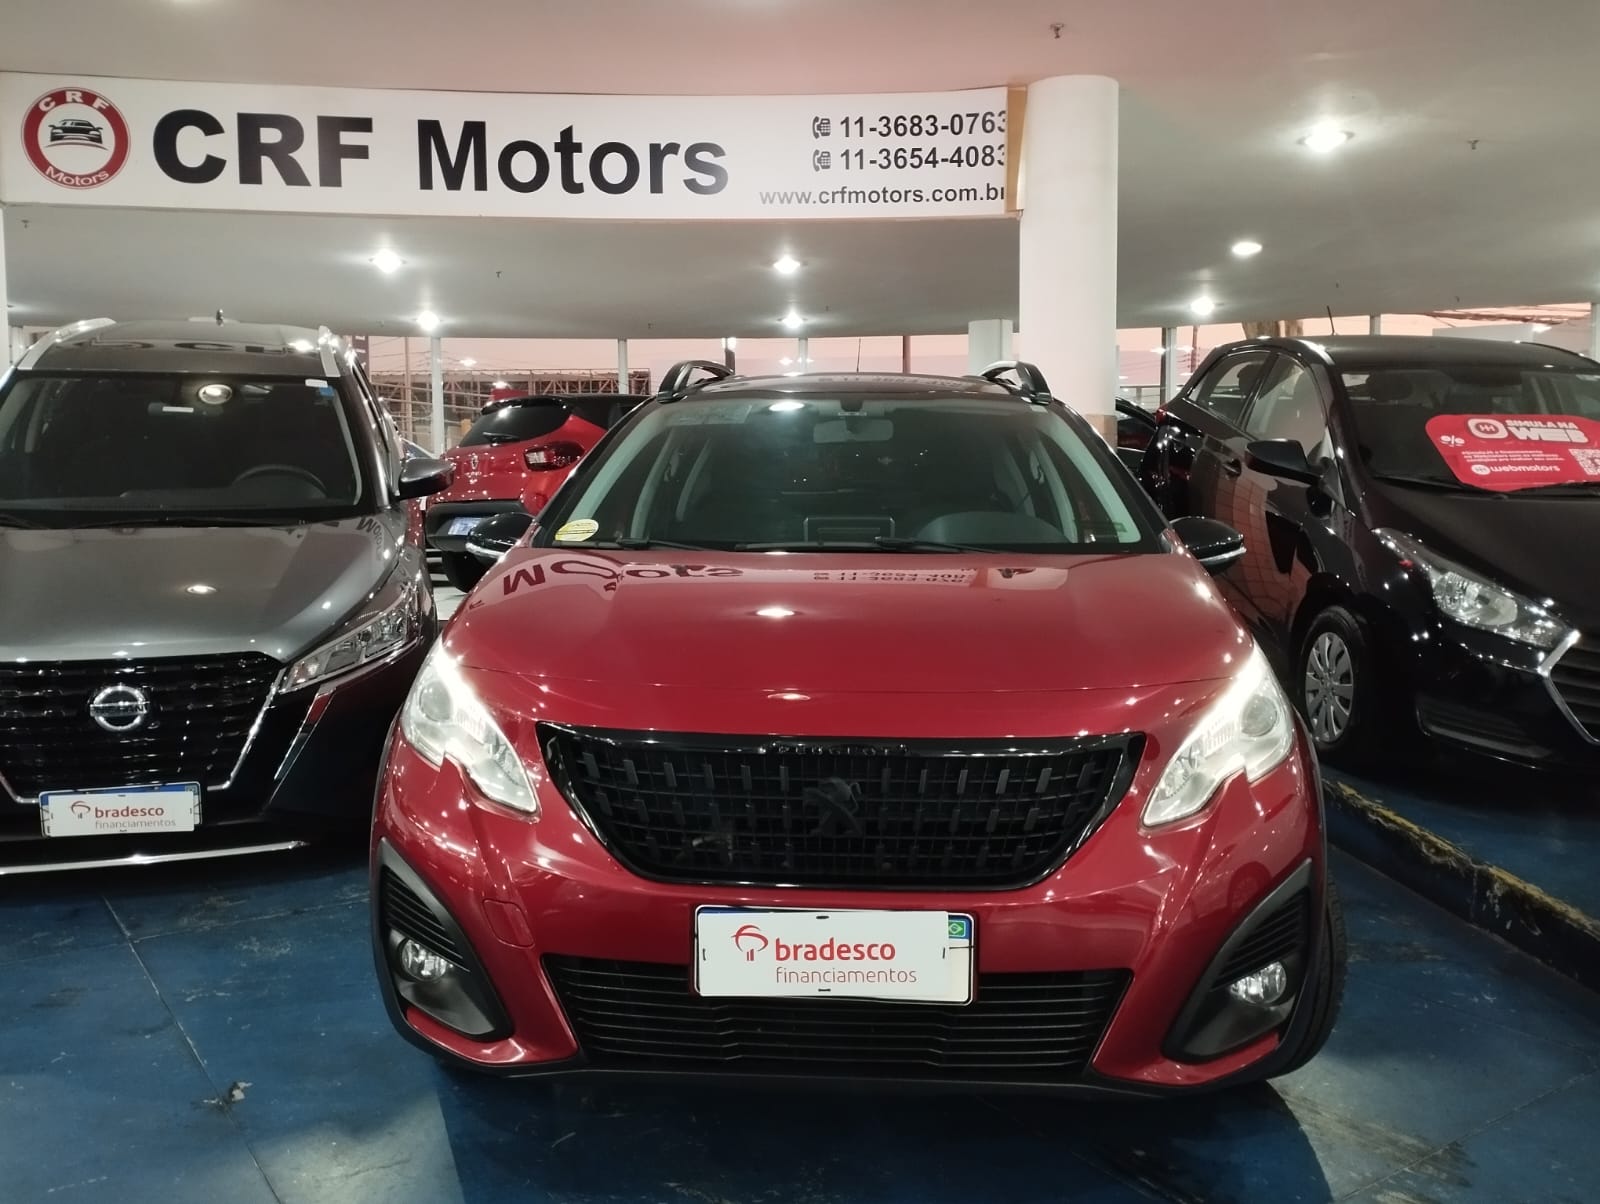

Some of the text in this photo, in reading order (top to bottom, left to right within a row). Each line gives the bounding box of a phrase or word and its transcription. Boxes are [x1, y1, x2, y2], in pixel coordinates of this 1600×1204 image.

[38, 90, 110, 113] CRF
[152, 108, 729, 196] CRF Motors
[44, 166, 110, 187] Motors
[1490, 464, 1560, 473] webmotors
[94, 805, 165, 819] bradesco
[95, 819, 176, 830] financiamentos
[775, 937, 896, 962] bradesco
[775, 966, 917, 984] financiamentos
